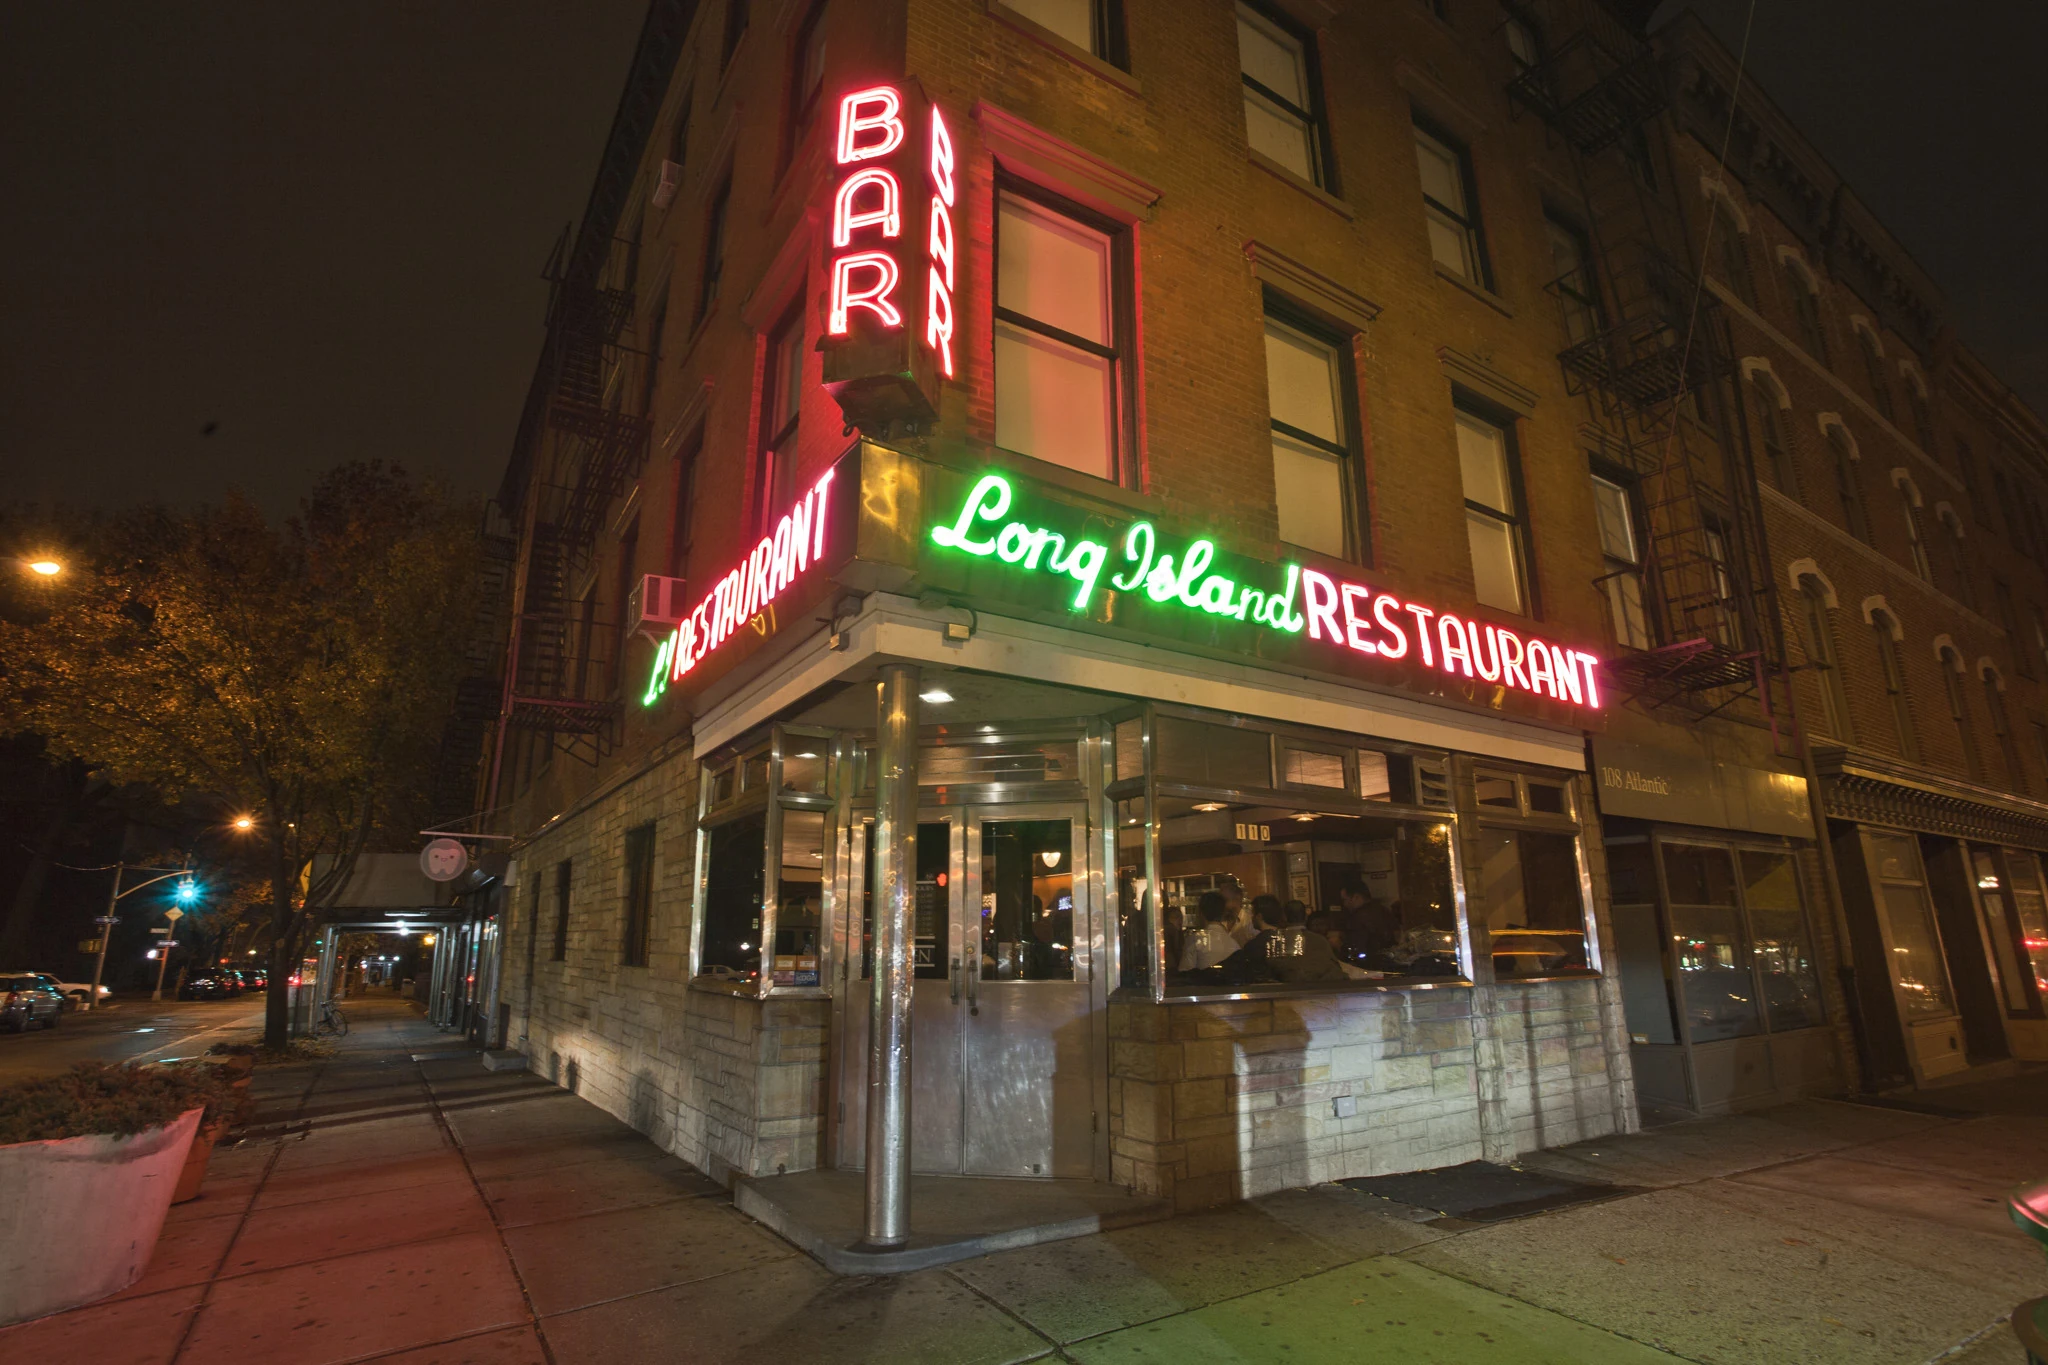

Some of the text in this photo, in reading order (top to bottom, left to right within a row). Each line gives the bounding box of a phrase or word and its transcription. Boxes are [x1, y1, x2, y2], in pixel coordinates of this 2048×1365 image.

[829, 85, 904, 336] BAR
[927, 102, 954, 379] BAR
[673, 466, 835, 681] RESTAURANT
[931, 474, 1599, 708] Long Island RESTAURANT
[1237, 824, 1270, 841] 110
[1602, 767, 1669, 796] 108 Atlantic
